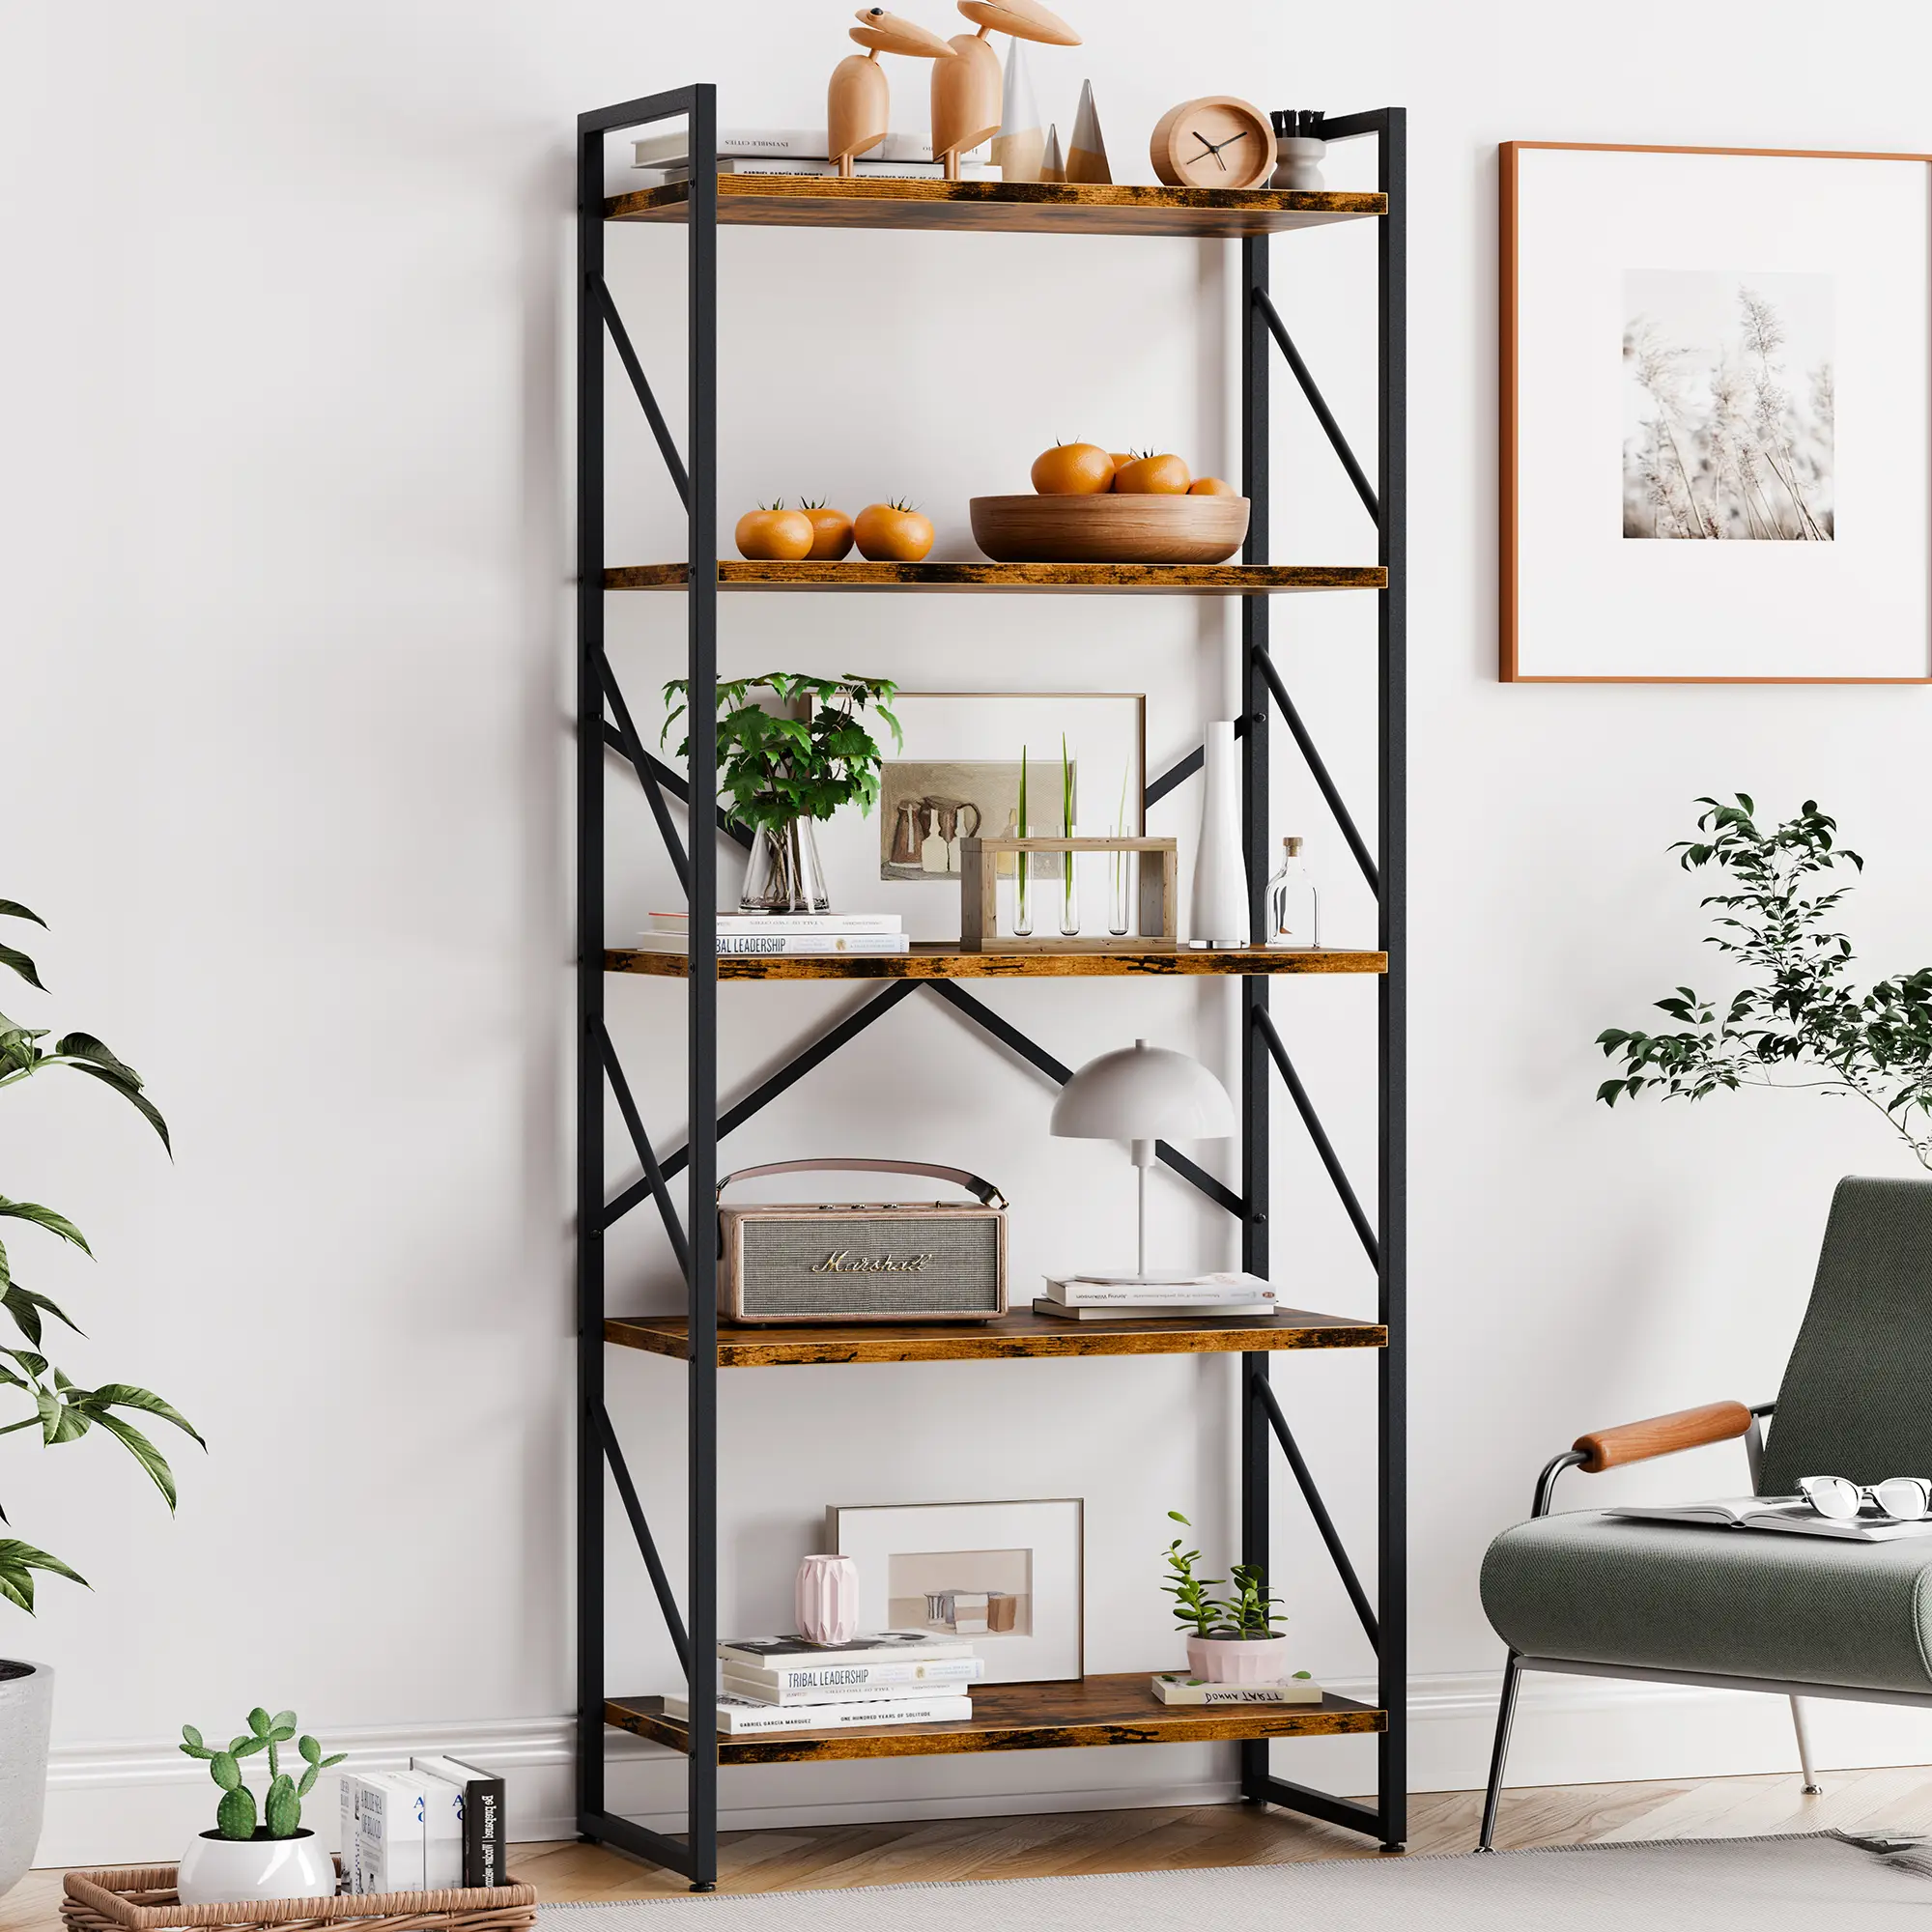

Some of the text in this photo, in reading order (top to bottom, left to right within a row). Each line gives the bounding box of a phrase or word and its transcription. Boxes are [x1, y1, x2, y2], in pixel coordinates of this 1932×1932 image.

[734, 938, 786, 952] LEADERSHIP
[810, 1250, 932, 1273] Marshall
[788, 1671, 818, 1689] TRIBAL
[820, 1668, 869, 1687] LEADERSHIP
